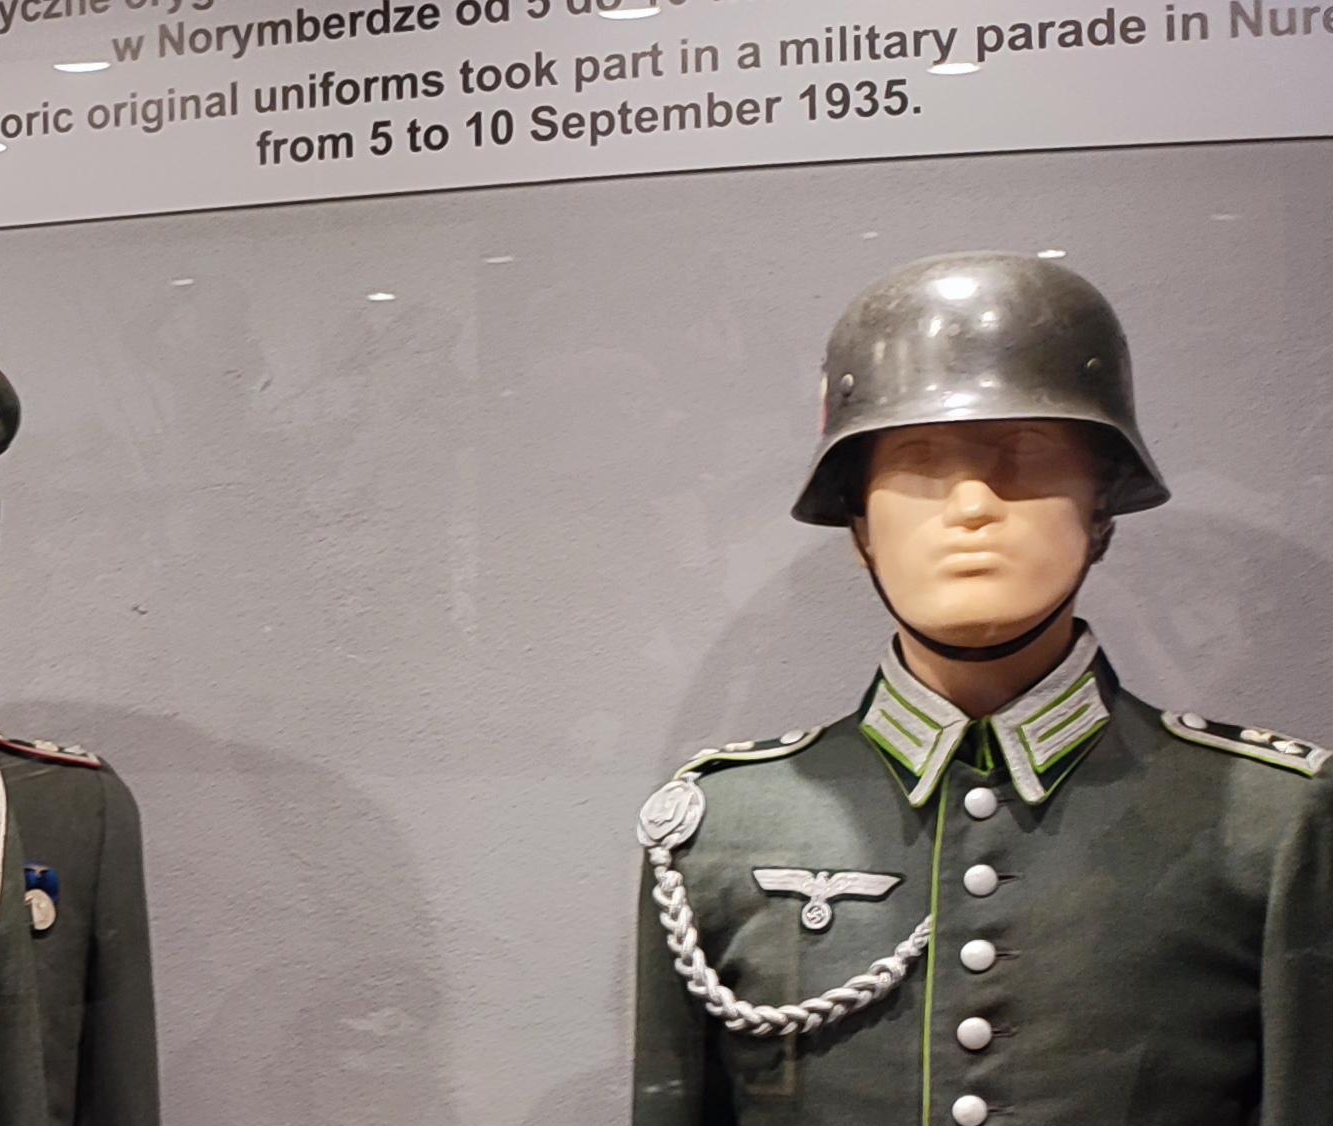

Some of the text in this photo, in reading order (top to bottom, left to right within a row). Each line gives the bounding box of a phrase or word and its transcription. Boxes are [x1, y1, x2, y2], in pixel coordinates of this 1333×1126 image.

[86, 82, 239, 134] original
[253, 67, 445, 114] uniforms
[459, 51, 559, 94] took
[574, 41, 665, 92] part
[679, 38, 720, 76] in
[737, 42, 762, 71] a
[778, 24, 959, 67] military
[975, 7, 1147, 63] parade
[1165, 3, 1210, 42] in
[112, 35, 145, 63] w
[157, 1, 441, 60] Norymberdze
[256, 77, 923, 166] from 5 to 10 September 1935.
